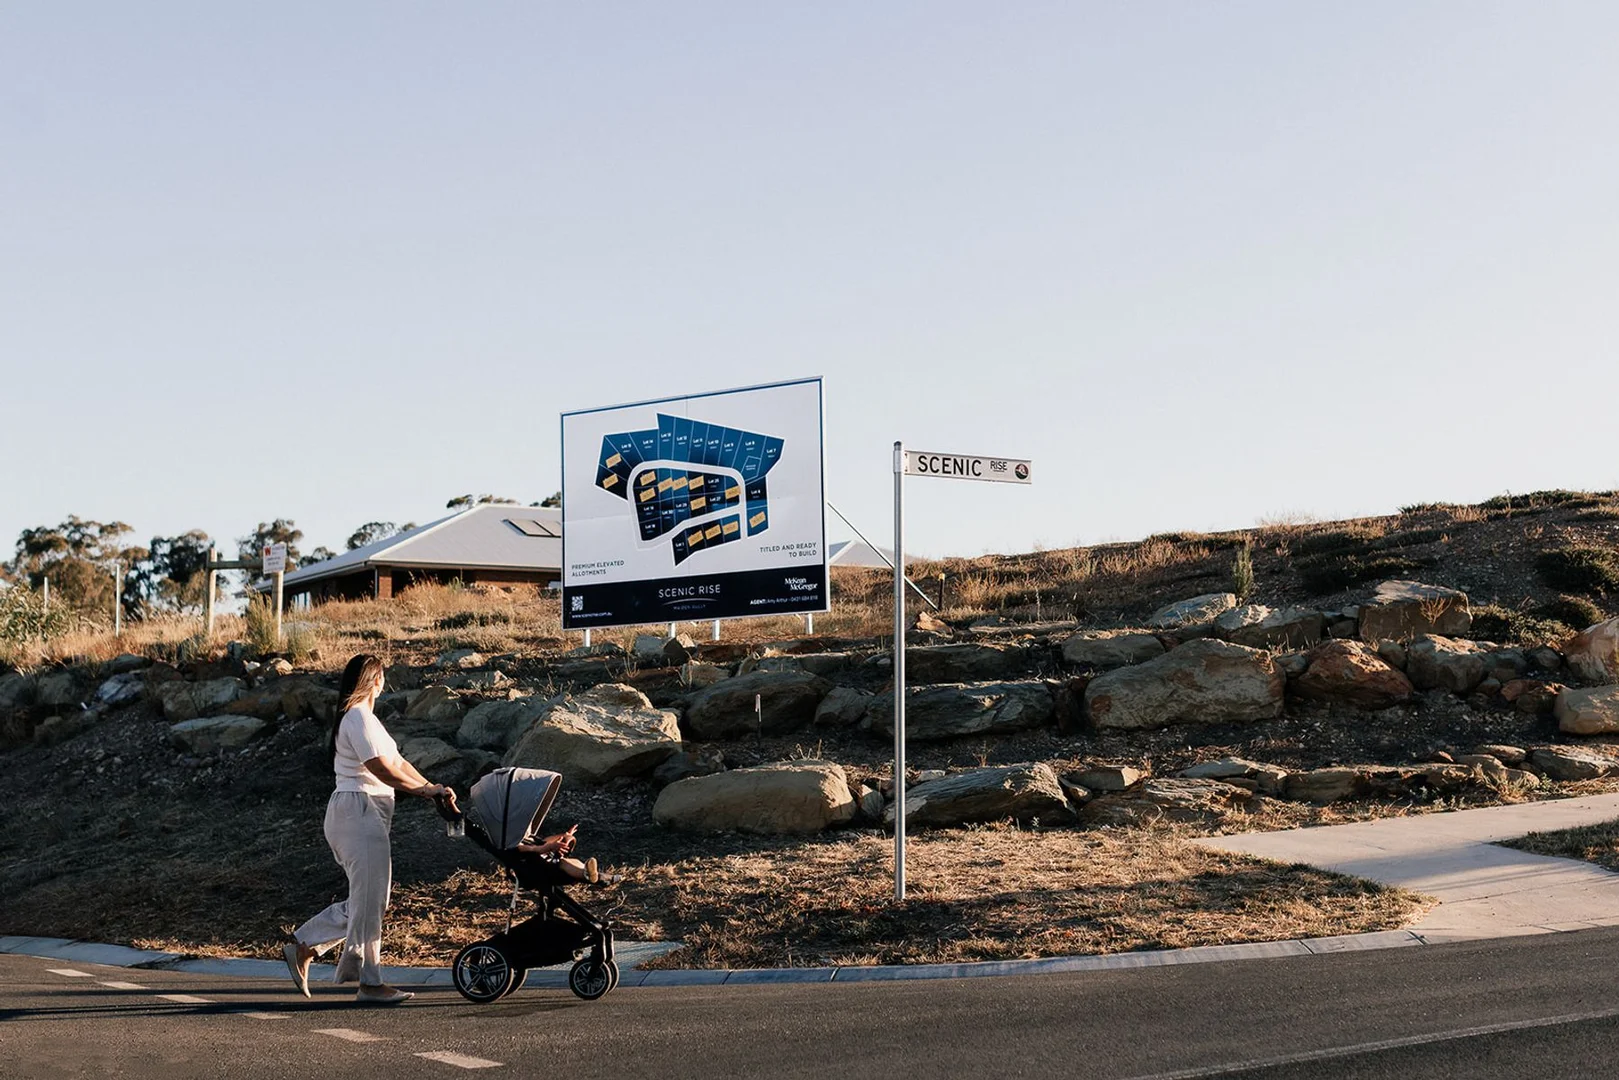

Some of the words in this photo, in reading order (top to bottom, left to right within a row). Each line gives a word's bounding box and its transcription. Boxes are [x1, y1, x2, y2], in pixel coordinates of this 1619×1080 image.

[918, 455, 982, 476] SCENIC
[990, 460, 1008, 470] RISE
[658, 586, 695, 598] SCENIC
[698, 584, 720, 595] RISE
